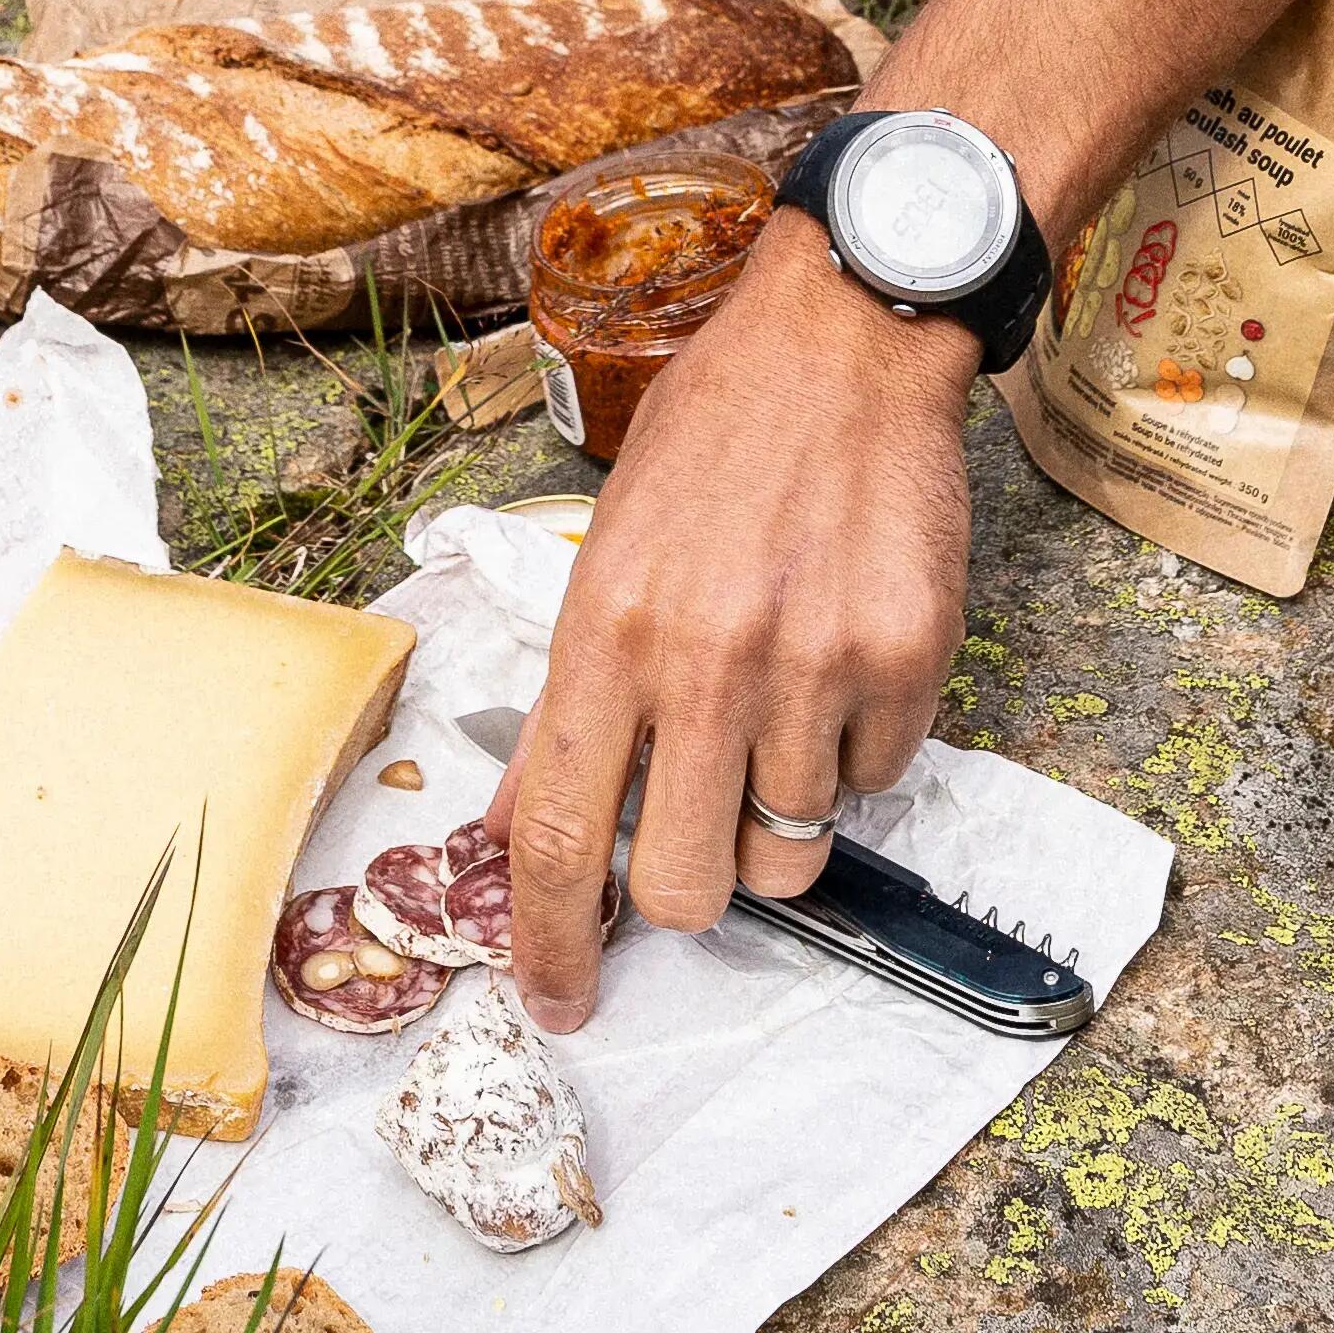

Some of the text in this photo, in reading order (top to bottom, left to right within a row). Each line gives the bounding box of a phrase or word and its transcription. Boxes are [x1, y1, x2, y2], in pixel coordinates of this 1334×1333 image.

[1184, 107, 1295, 188] oulash soup
[1237, 106, 1265, 132] au
[1259, 123, 1324, 169] poulet
[1182, 166, 1196, 182] 50
[1227, 197, 1247, 217] 18%
[1277, 227, 1308, 248] 100%
[1141, 413, 1167, 430] Soupe
[1132, 422, 1223, 467] Soup to be rehydrated
[1238, 481, 1260, 498] 350
[1262, 494, 1269, 504] g
